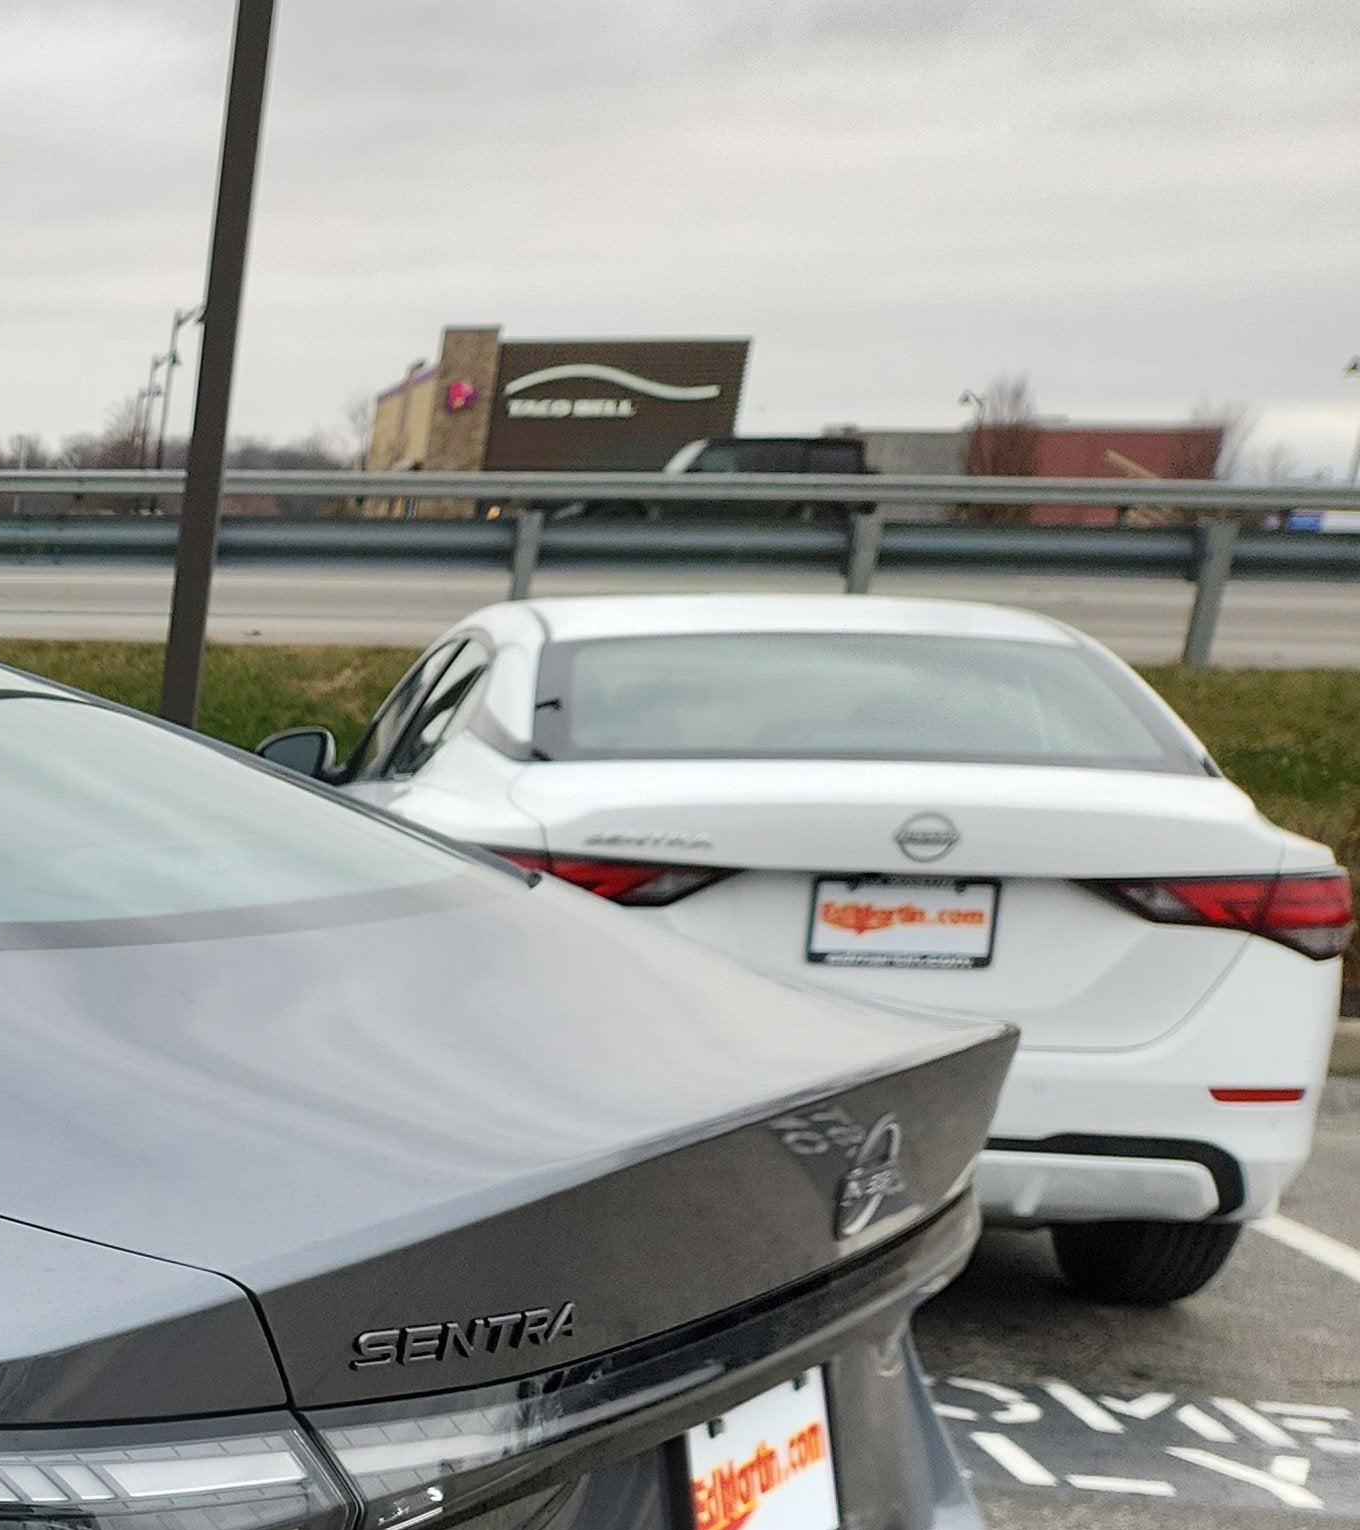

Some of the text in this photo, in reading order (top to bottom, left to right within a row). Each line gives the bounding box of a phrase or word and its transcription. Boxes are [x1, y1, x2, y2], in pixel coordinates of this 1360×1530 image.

[508, 399, 637, 418] TACO BELL
[350, 1301, 576, 1370] SENTRA
